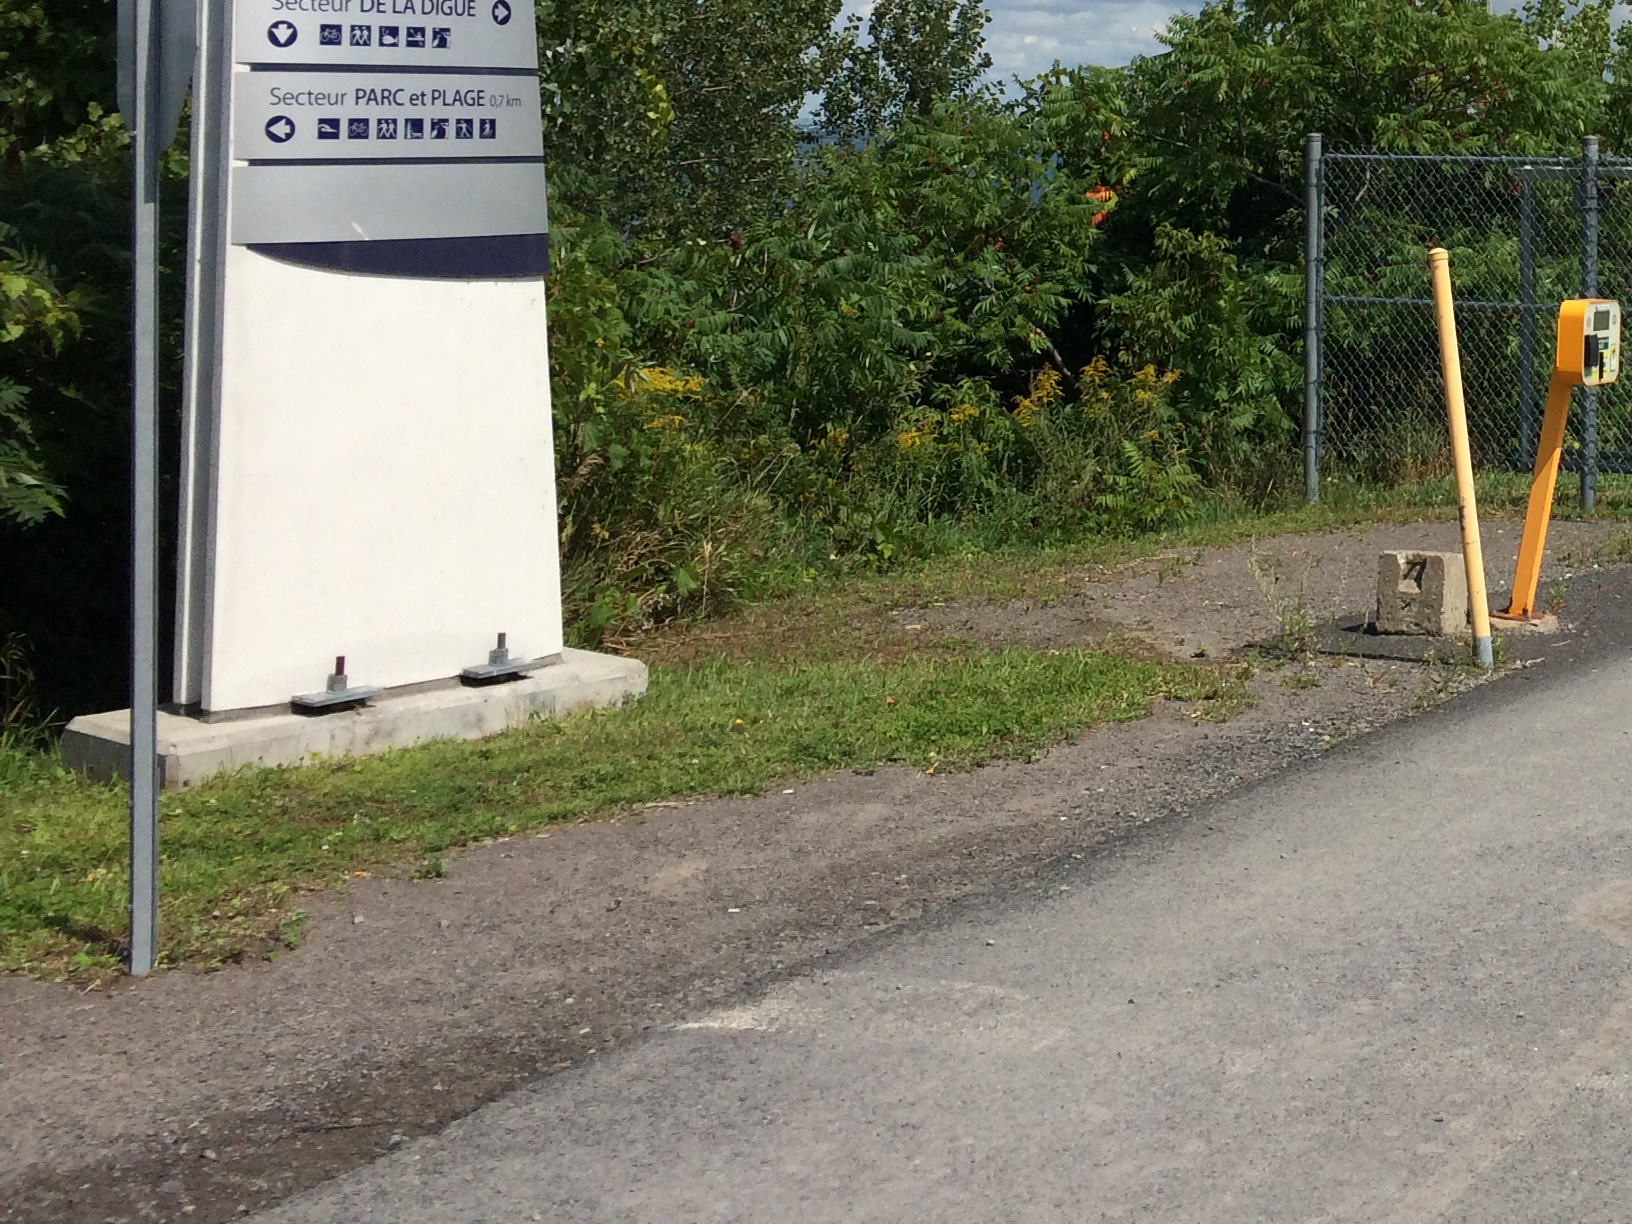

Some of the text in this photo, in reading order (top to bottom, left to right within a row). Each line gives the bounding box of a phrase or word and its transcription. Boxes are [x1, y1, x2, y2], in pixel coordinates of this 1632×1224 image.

[269, 87, 522, 109] Secteur PARC et PLAGE 0,7 km
